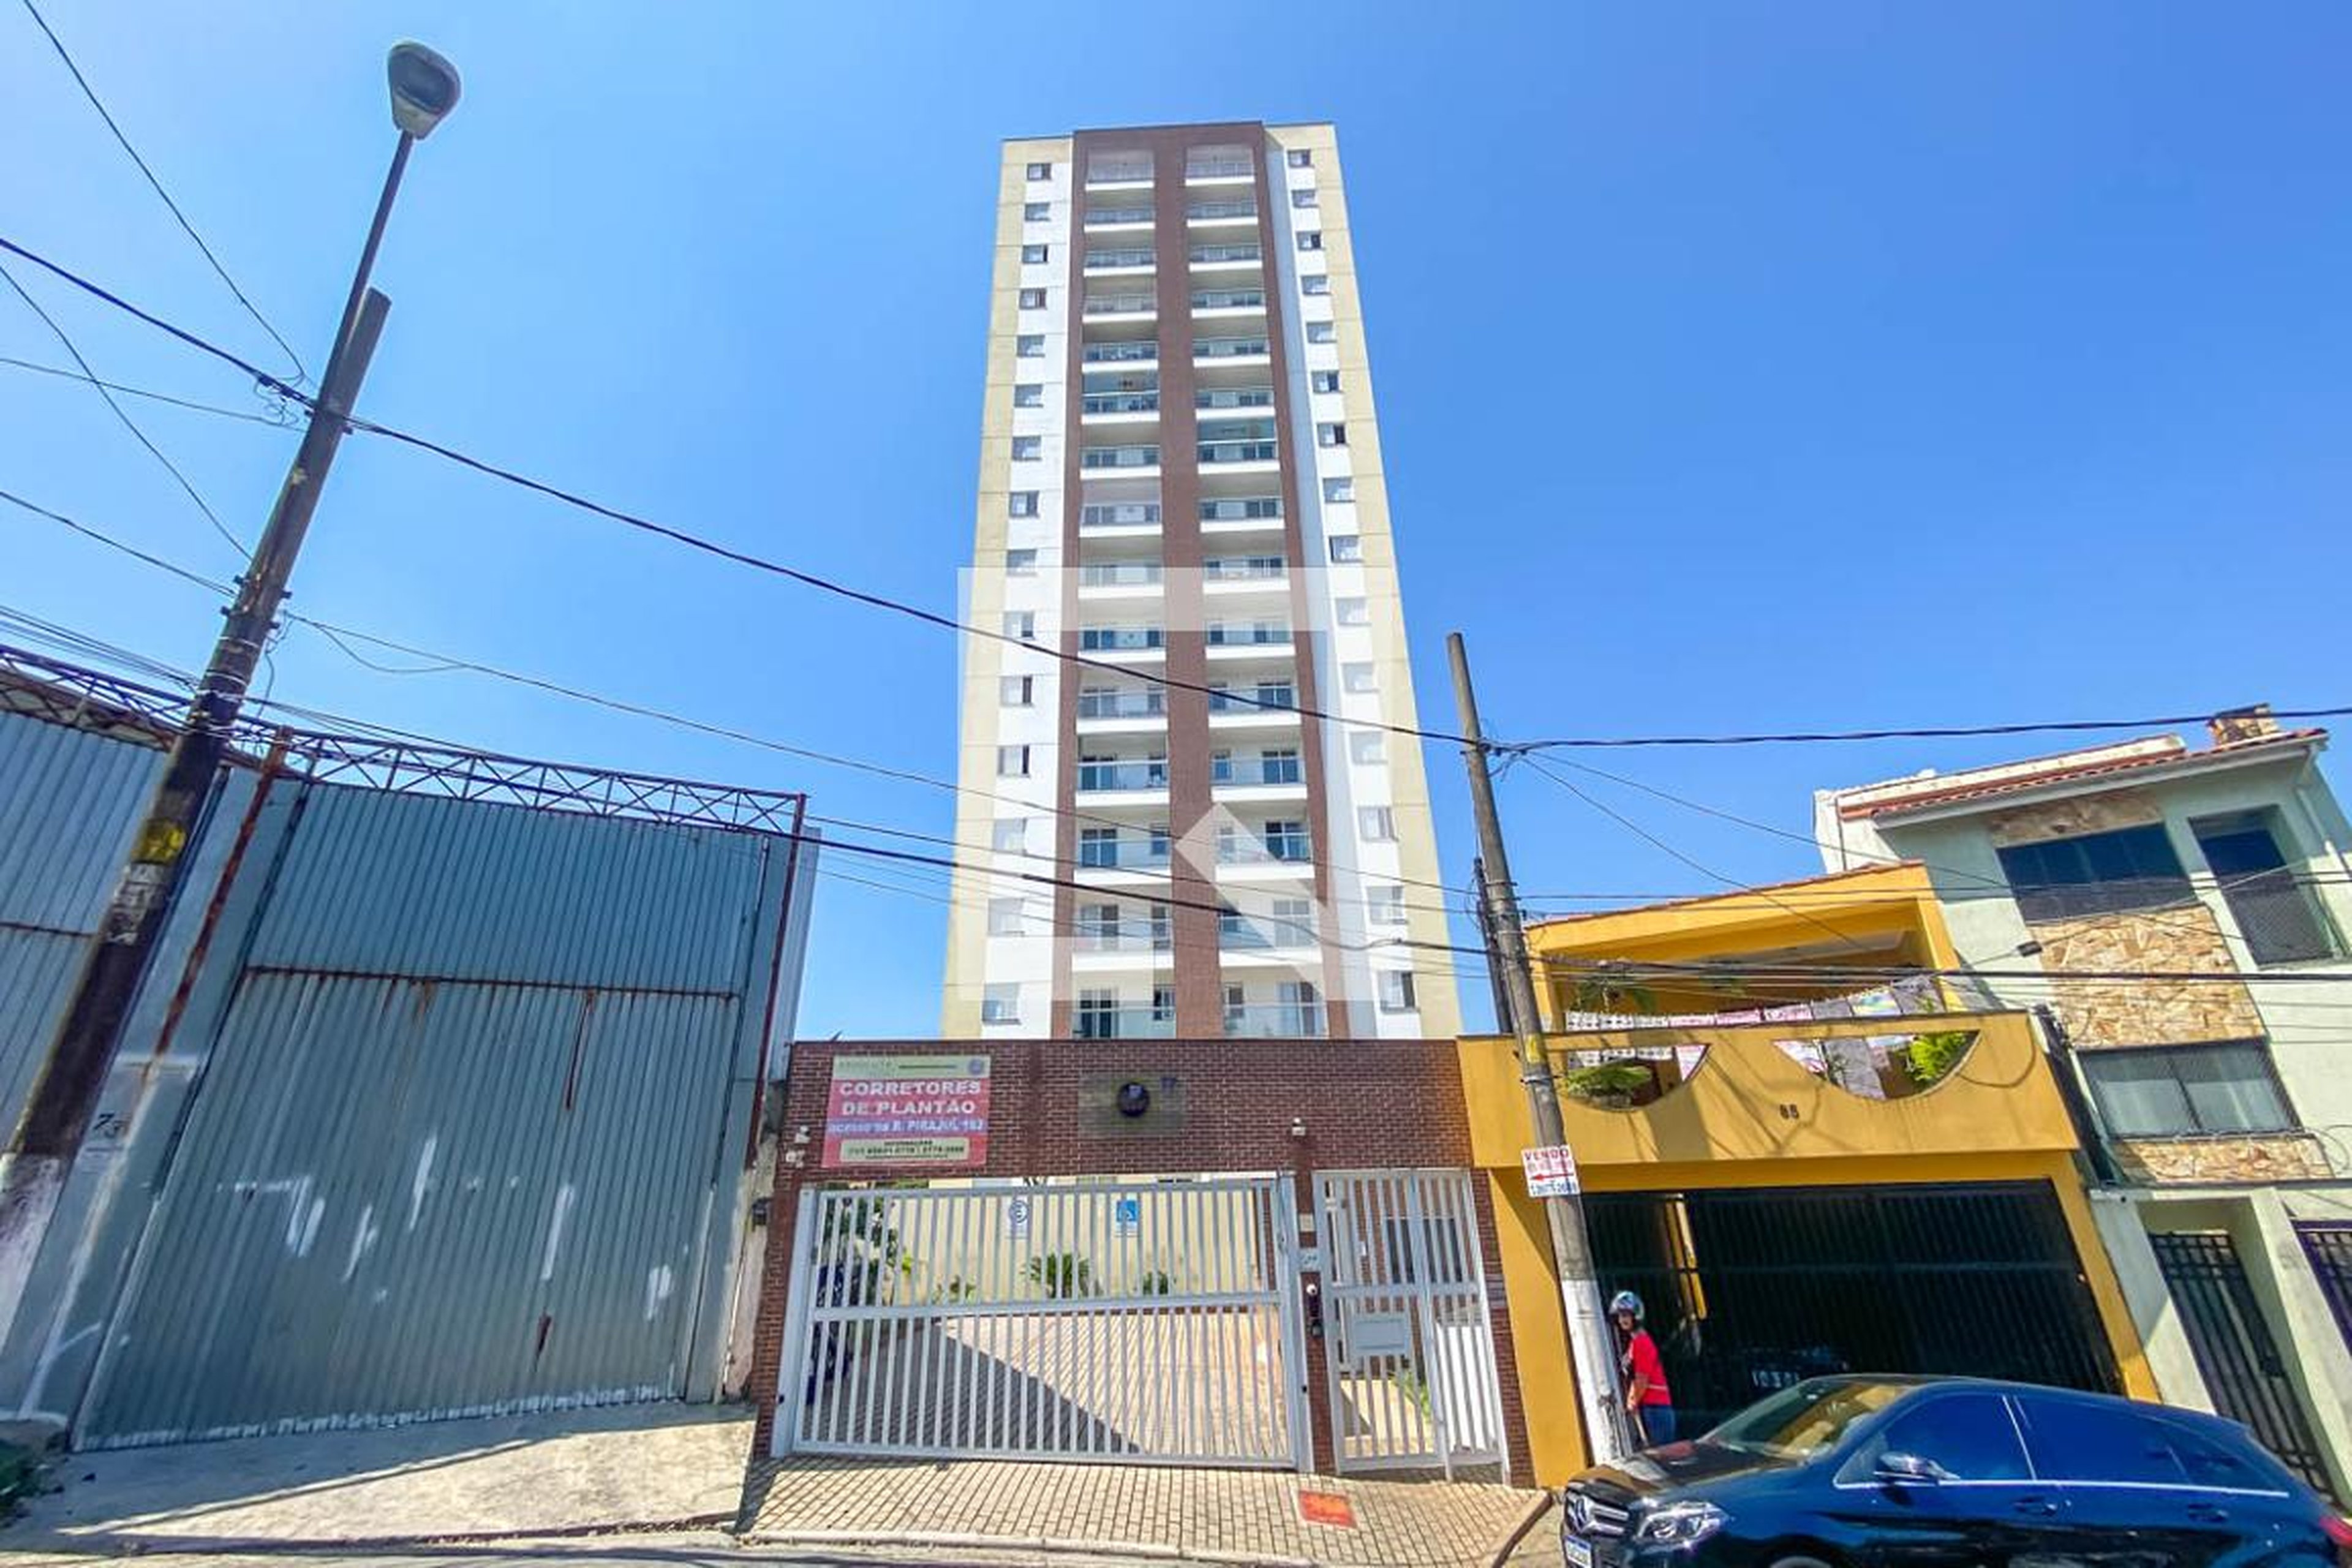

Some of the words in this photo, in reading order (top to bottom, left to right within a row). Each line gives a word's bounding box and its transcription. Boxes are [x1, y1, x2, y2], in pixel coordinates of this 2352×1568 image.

[840, 1080, 981, 1095] CORRETORES
[842, 1101, 871, 1115] DE
[877, 1100, 976, 1115] PLANTÃO
[1525, 1148, 1569, 1161] VENDO
